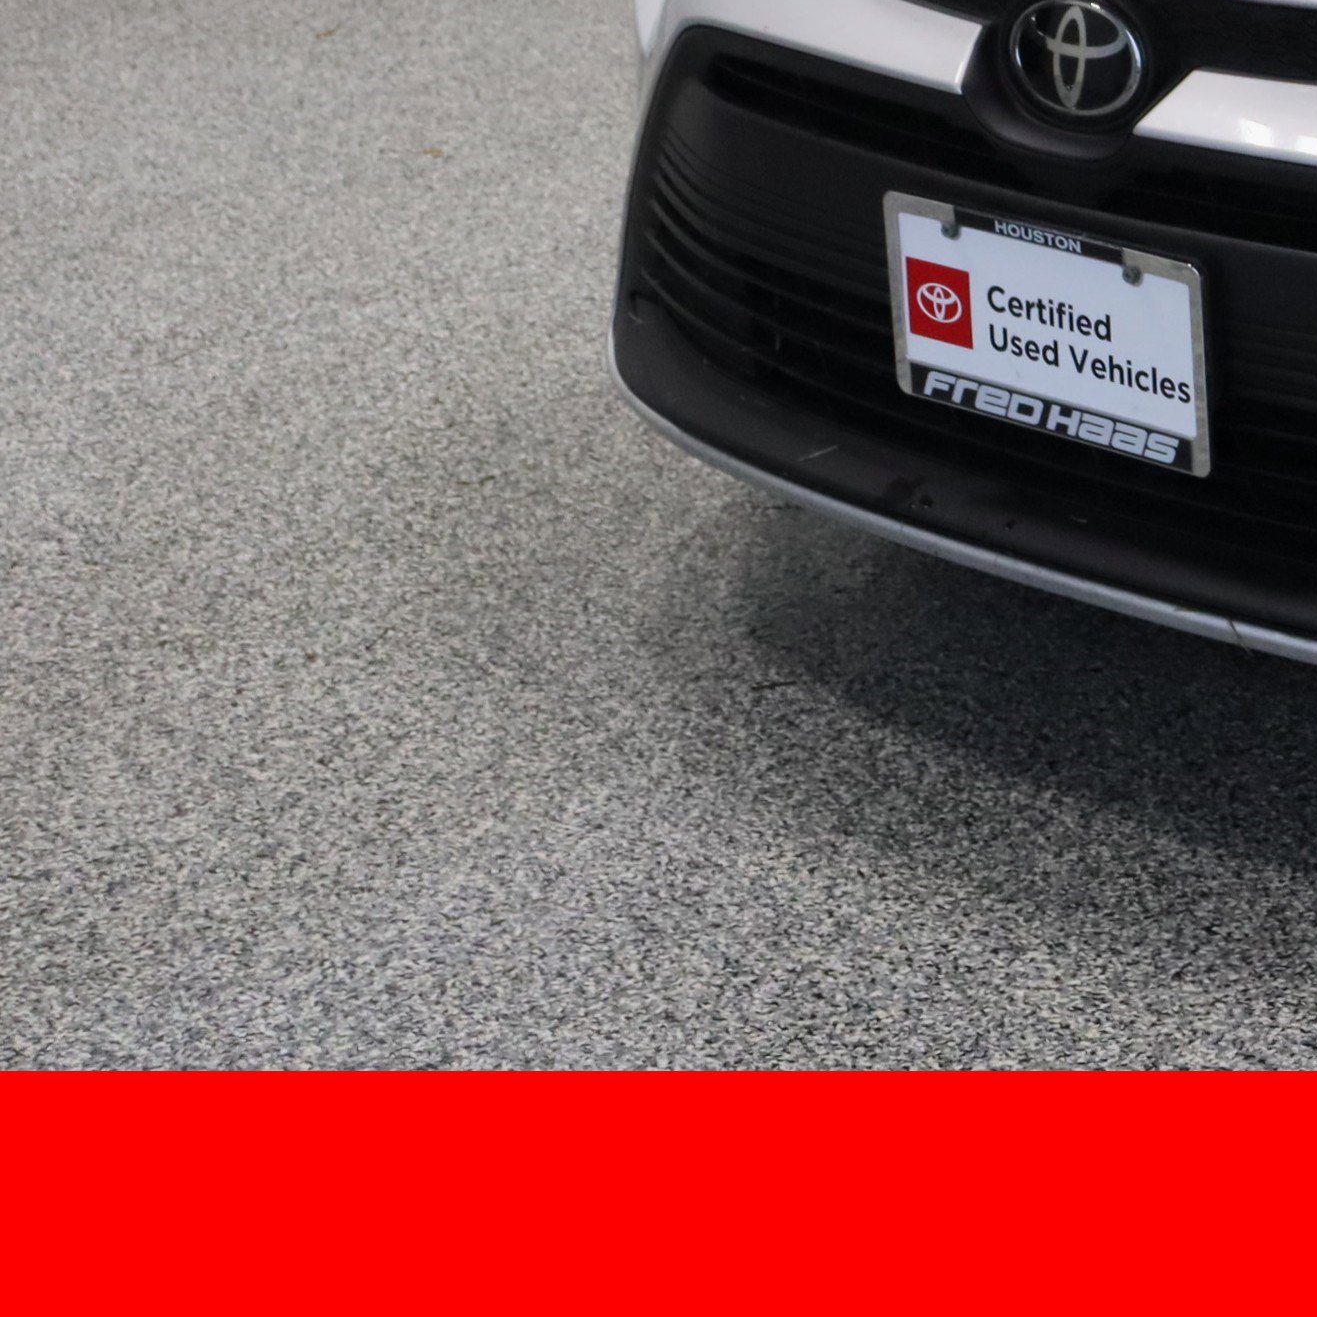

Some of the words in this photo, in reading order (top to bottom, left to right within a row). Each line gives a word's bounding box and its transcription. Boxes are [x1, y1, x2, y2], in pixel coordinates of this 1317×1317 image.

[993, 219, 1083, 255] HOUSTON
[986, 285, 1113, 343] Certified
[988, 323, 1060, 368] Used
[1068, 344, 1192, 404] Vehicles
